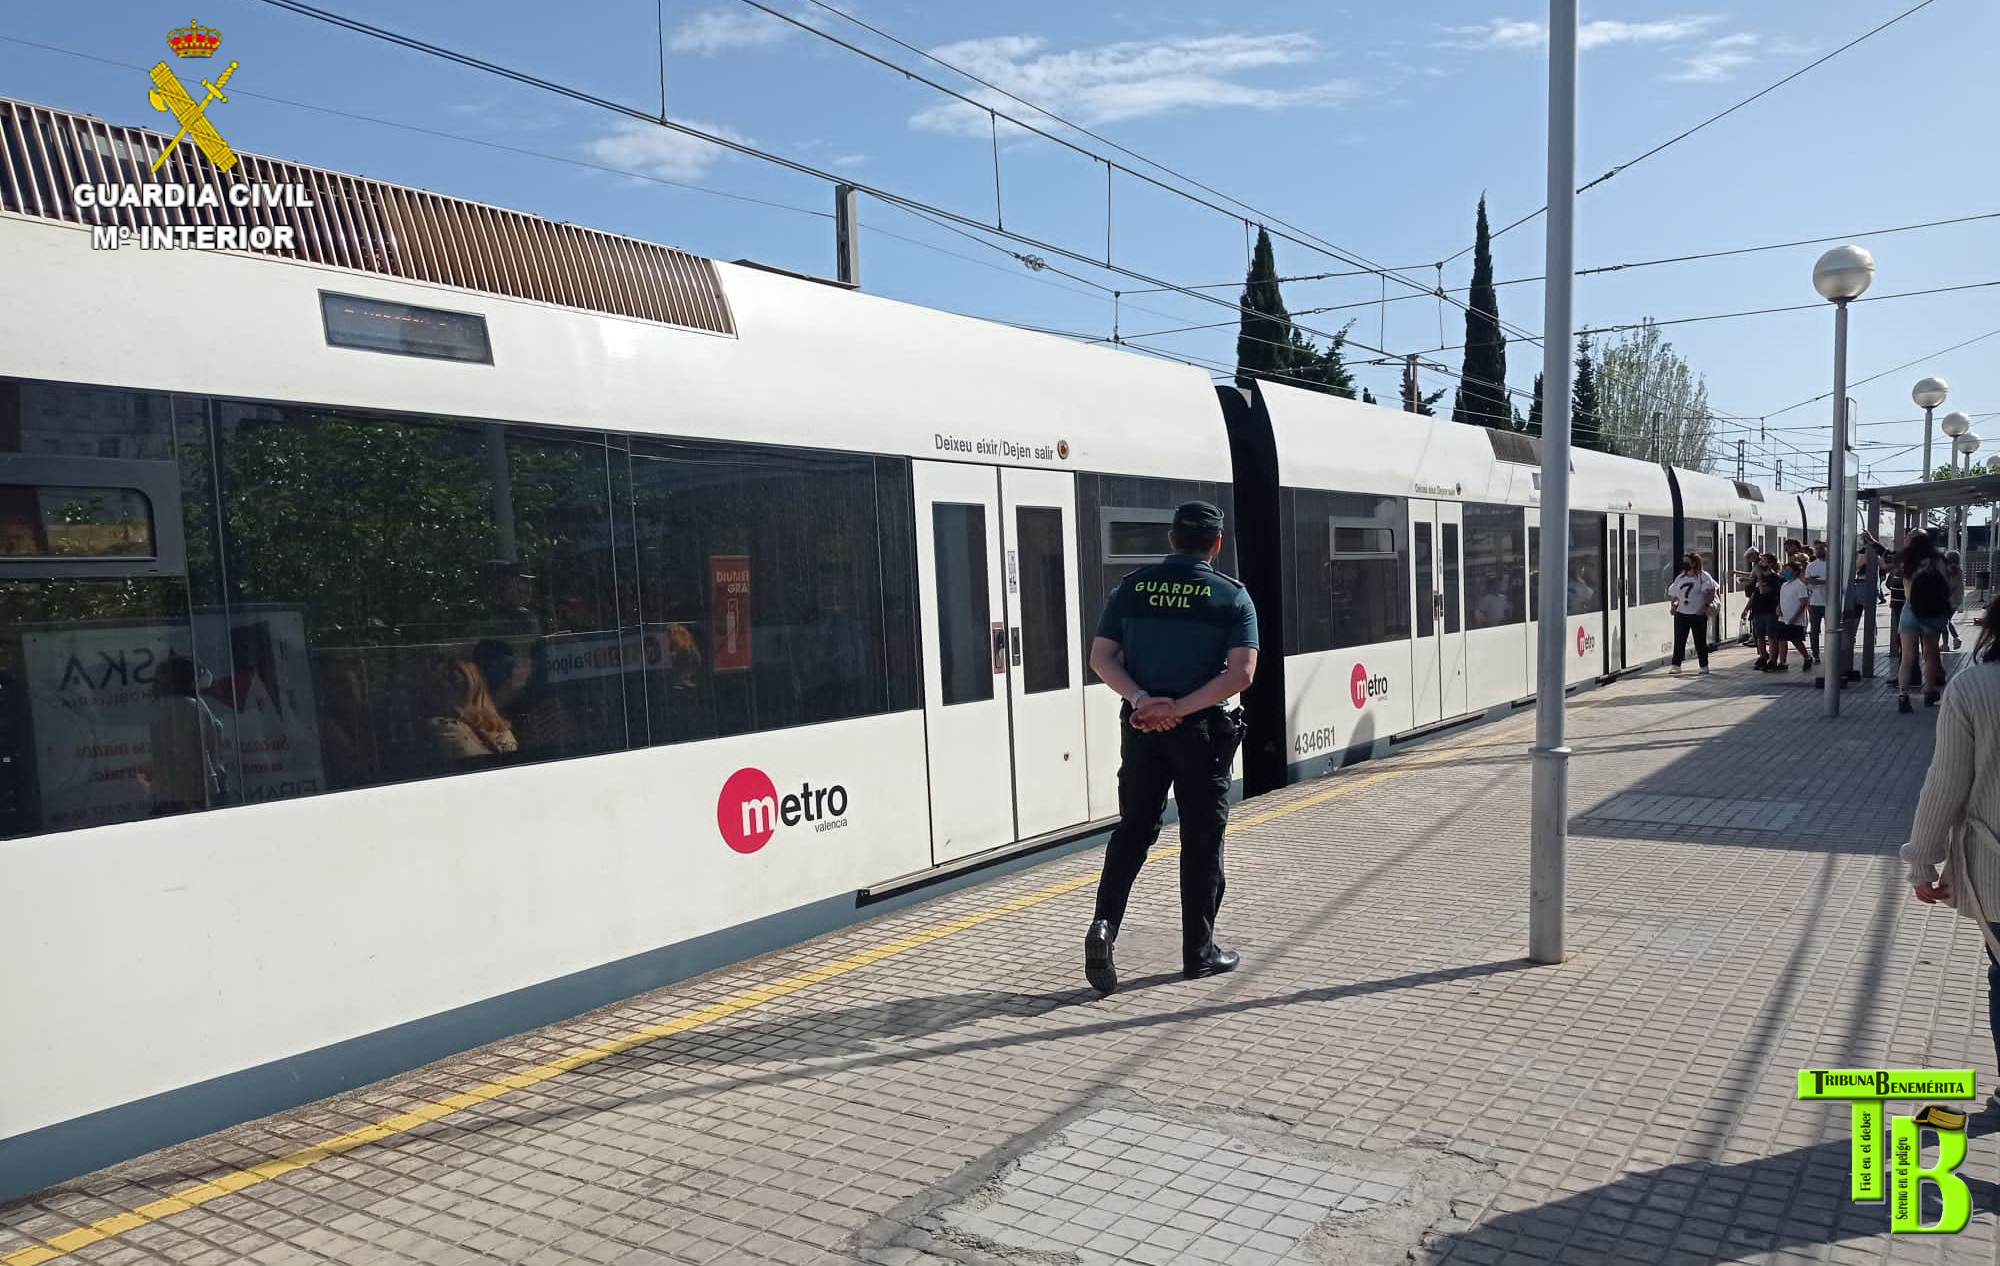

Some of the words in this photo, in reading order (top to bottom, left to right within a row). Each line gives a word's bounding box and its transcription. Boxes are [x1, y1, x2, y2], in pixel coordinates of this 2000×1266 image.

[935, 434, 972, 452] Deixeu
[977, 438, 1031, 459] eixir/Dejen
[1034, 445, 1054, 460] salir
[1135, 581, 1212, 597] GUARDIA
[1148, 594, 1191, 608] CIVIL
[1356, 674, 1388, 700] metro
[1294, 725, 1335, 755] 4346R1
[741, 782, 848, 837] metro
[814, 817, 848, 833] valencia
